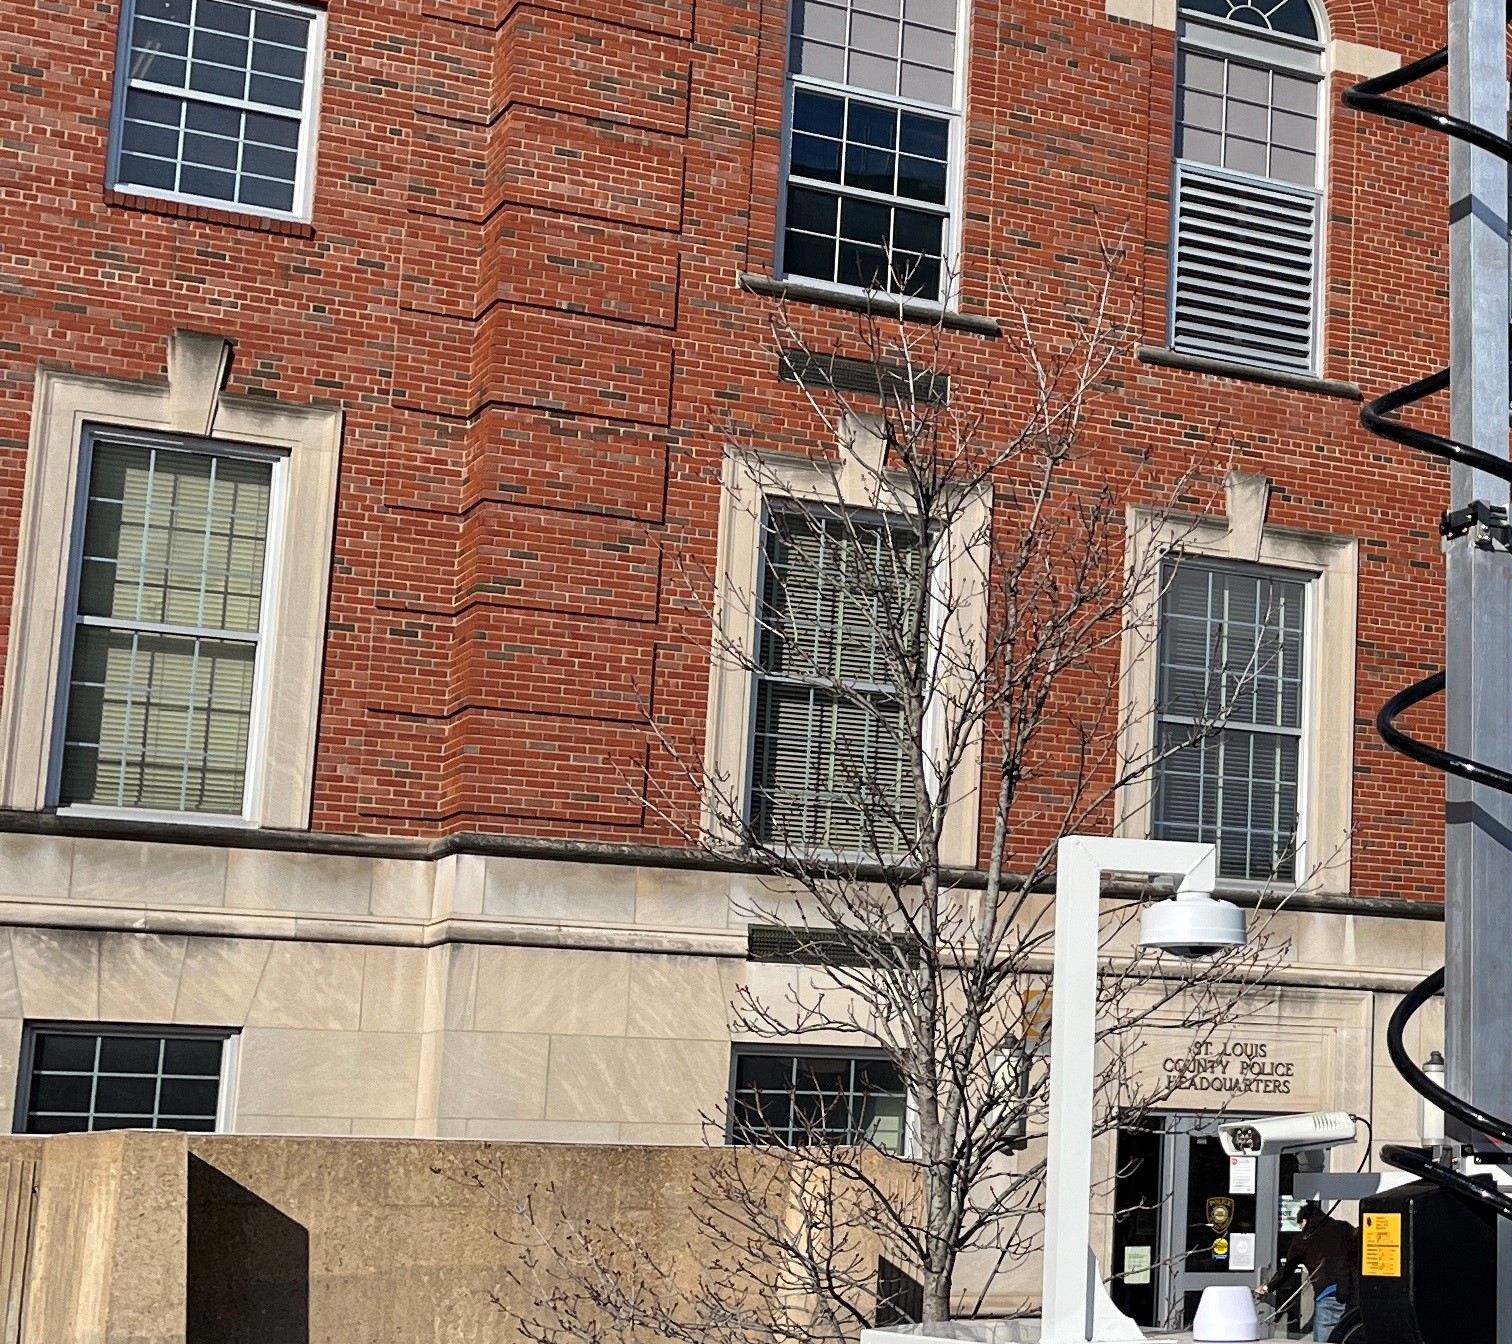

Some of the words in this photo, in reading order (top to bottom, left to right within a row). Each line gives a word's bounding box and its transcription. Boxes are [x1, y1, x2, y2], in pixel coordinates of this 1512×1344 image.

[1220, 1042, 1267, 1057] LOUIS
[1163, 1058, 1230, 1075] COUNTY
[1240, 1061, 1294, 1077] POLICE
[1167, 1075, 1291, 1094] HEADQUARTERS
